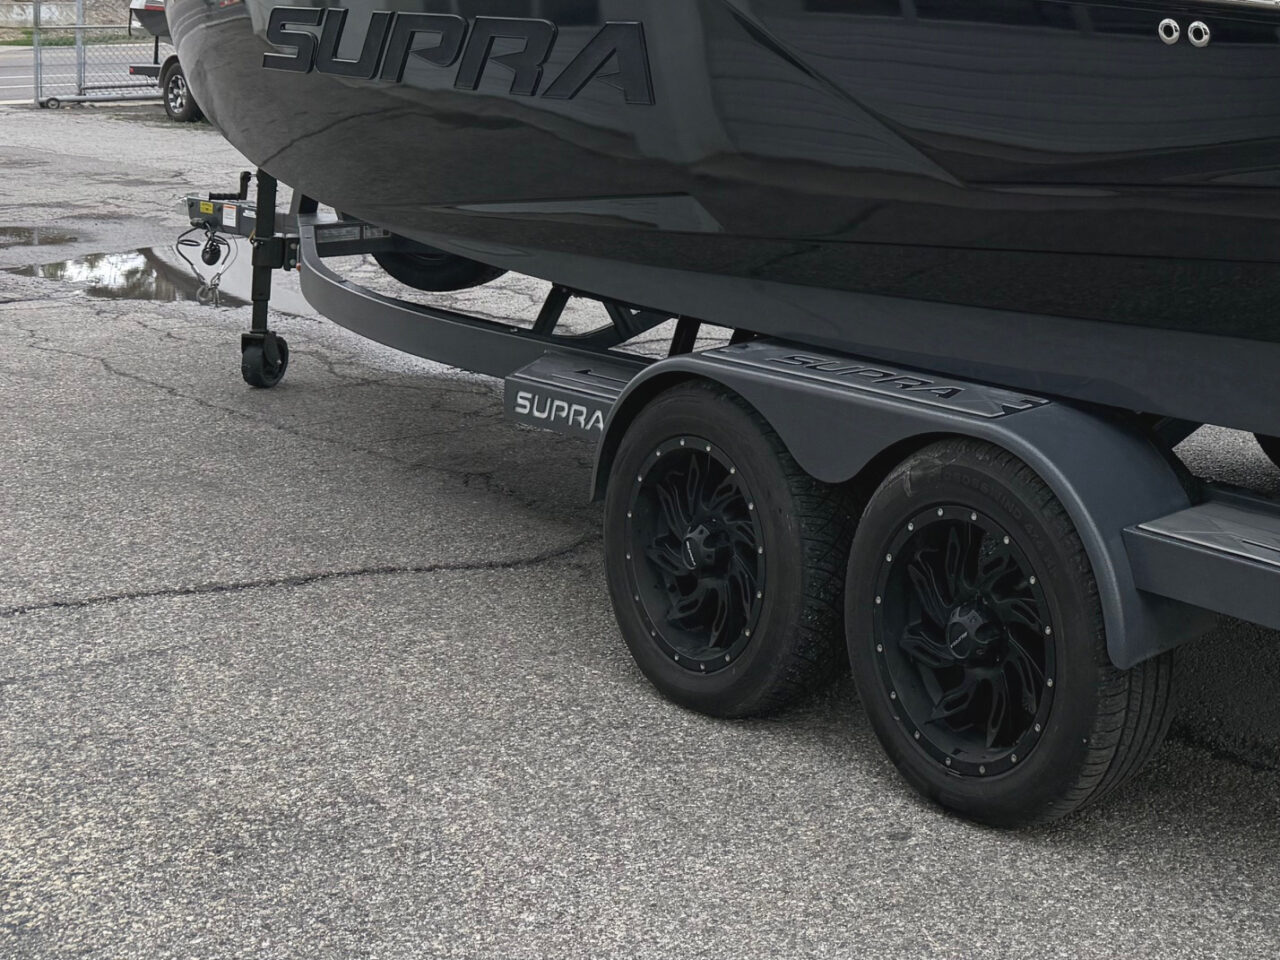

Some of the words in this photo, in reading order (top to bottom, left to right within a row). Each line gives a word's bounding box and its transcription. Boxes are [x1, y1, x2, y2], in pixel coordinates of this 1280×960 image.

[262, 6, 657, 106] SUPRA
[768, 355, 965, 400] SUPRA
[515, 391, 605, 431] SUPRA
